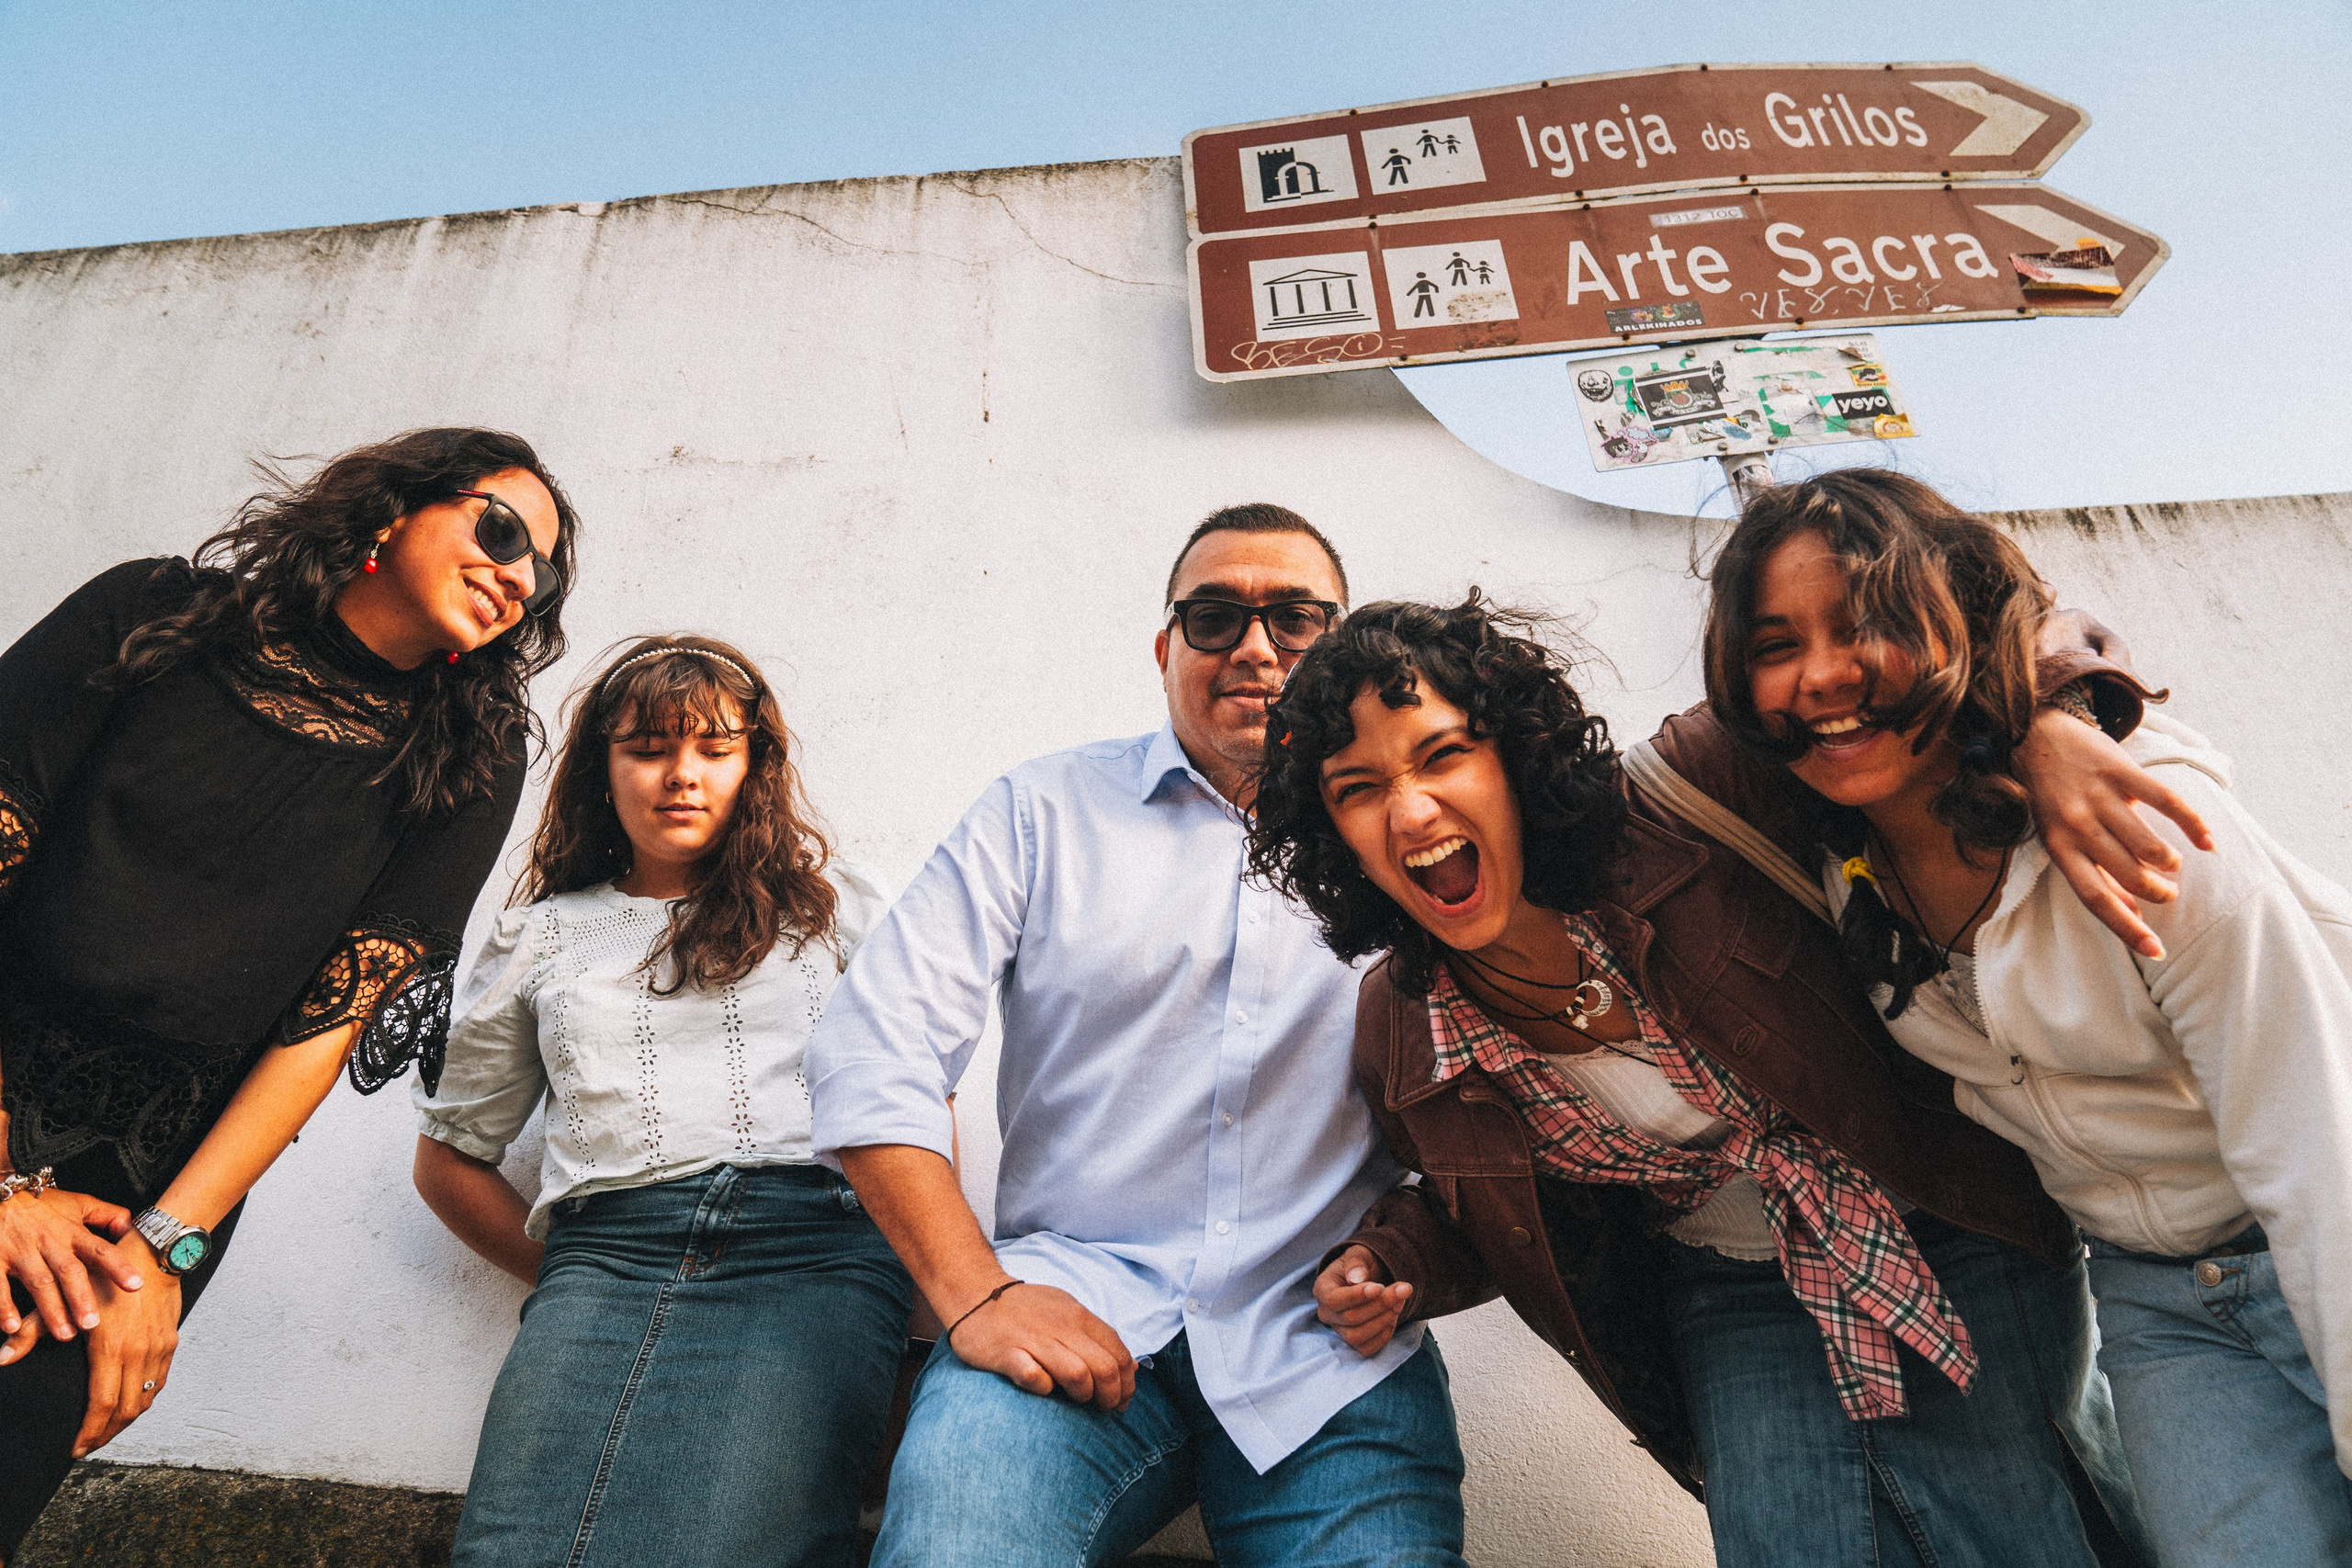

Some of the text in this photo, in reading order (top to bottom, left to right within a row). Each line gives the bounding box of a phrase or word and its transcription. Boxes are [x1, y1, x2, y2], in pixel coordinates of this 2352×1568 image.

[1516, 91, 1928, 178] Igreja dos Grilos
[1566, 221, 1999, 306] Arte Sacra
[1614, 318, 1703, 333] ARLEKINADOS
[1838, 395, 1888, 414] yeyo
